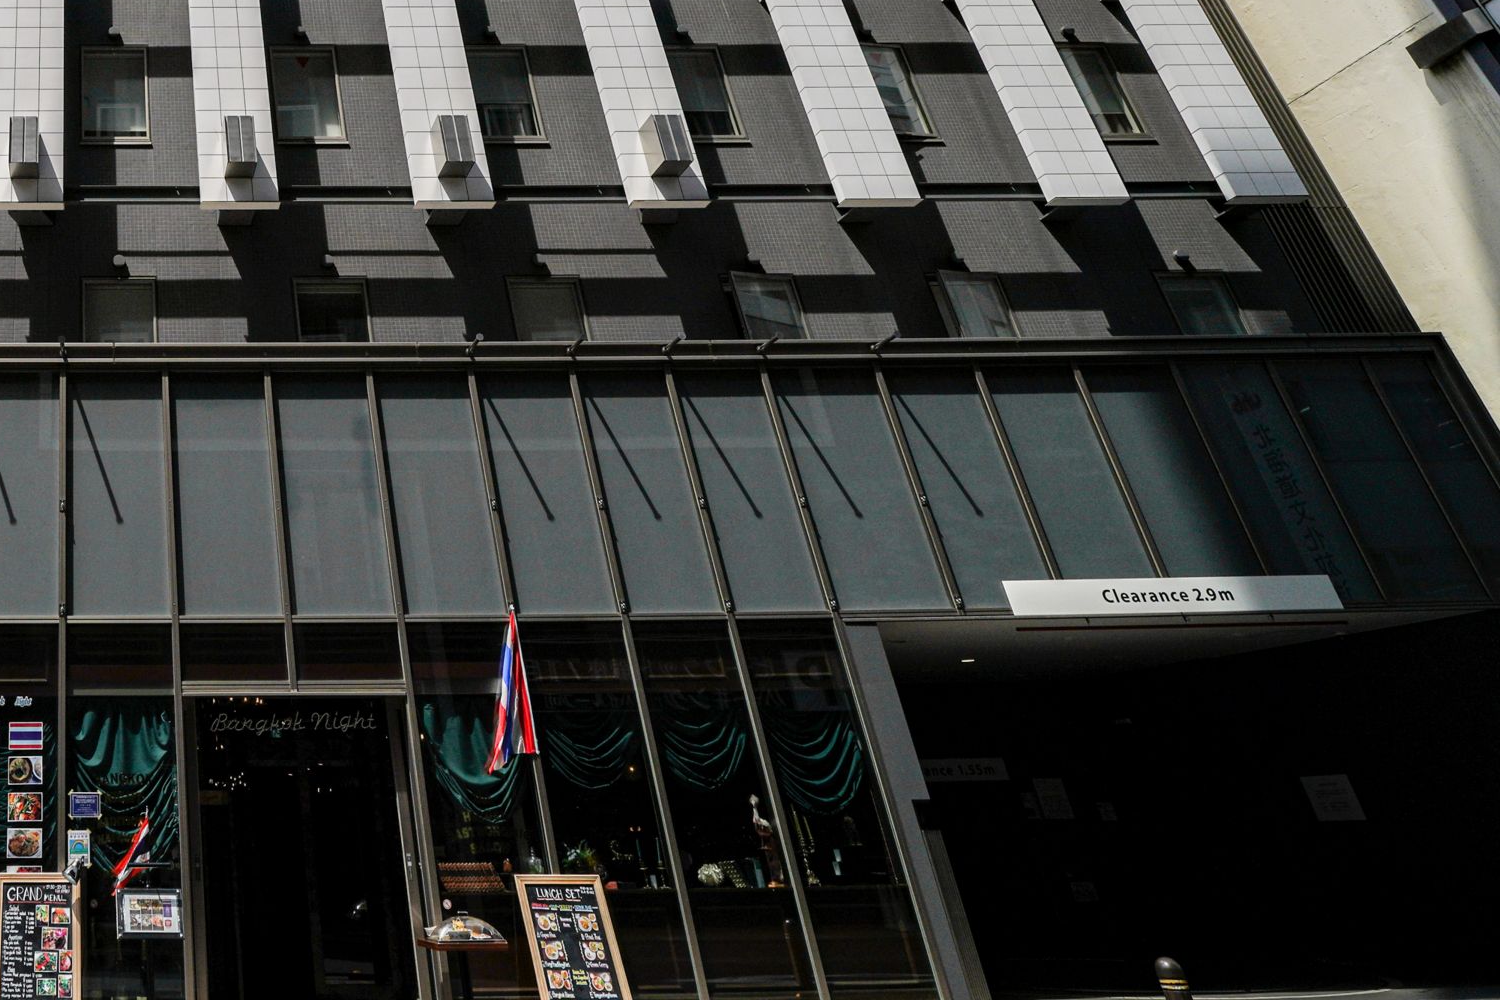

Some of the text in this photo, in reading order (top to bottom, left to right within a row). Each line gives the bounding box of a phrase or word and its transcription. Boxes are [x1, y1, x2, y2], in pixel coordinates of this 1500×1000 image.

[1102, 587, 1236, 603] Clearance 2.9m
[209, 710, 378, 736] Bangkok Night
[7, 886, 43, 901] GRAND
[535, 887, 563, 899] LUNCH
